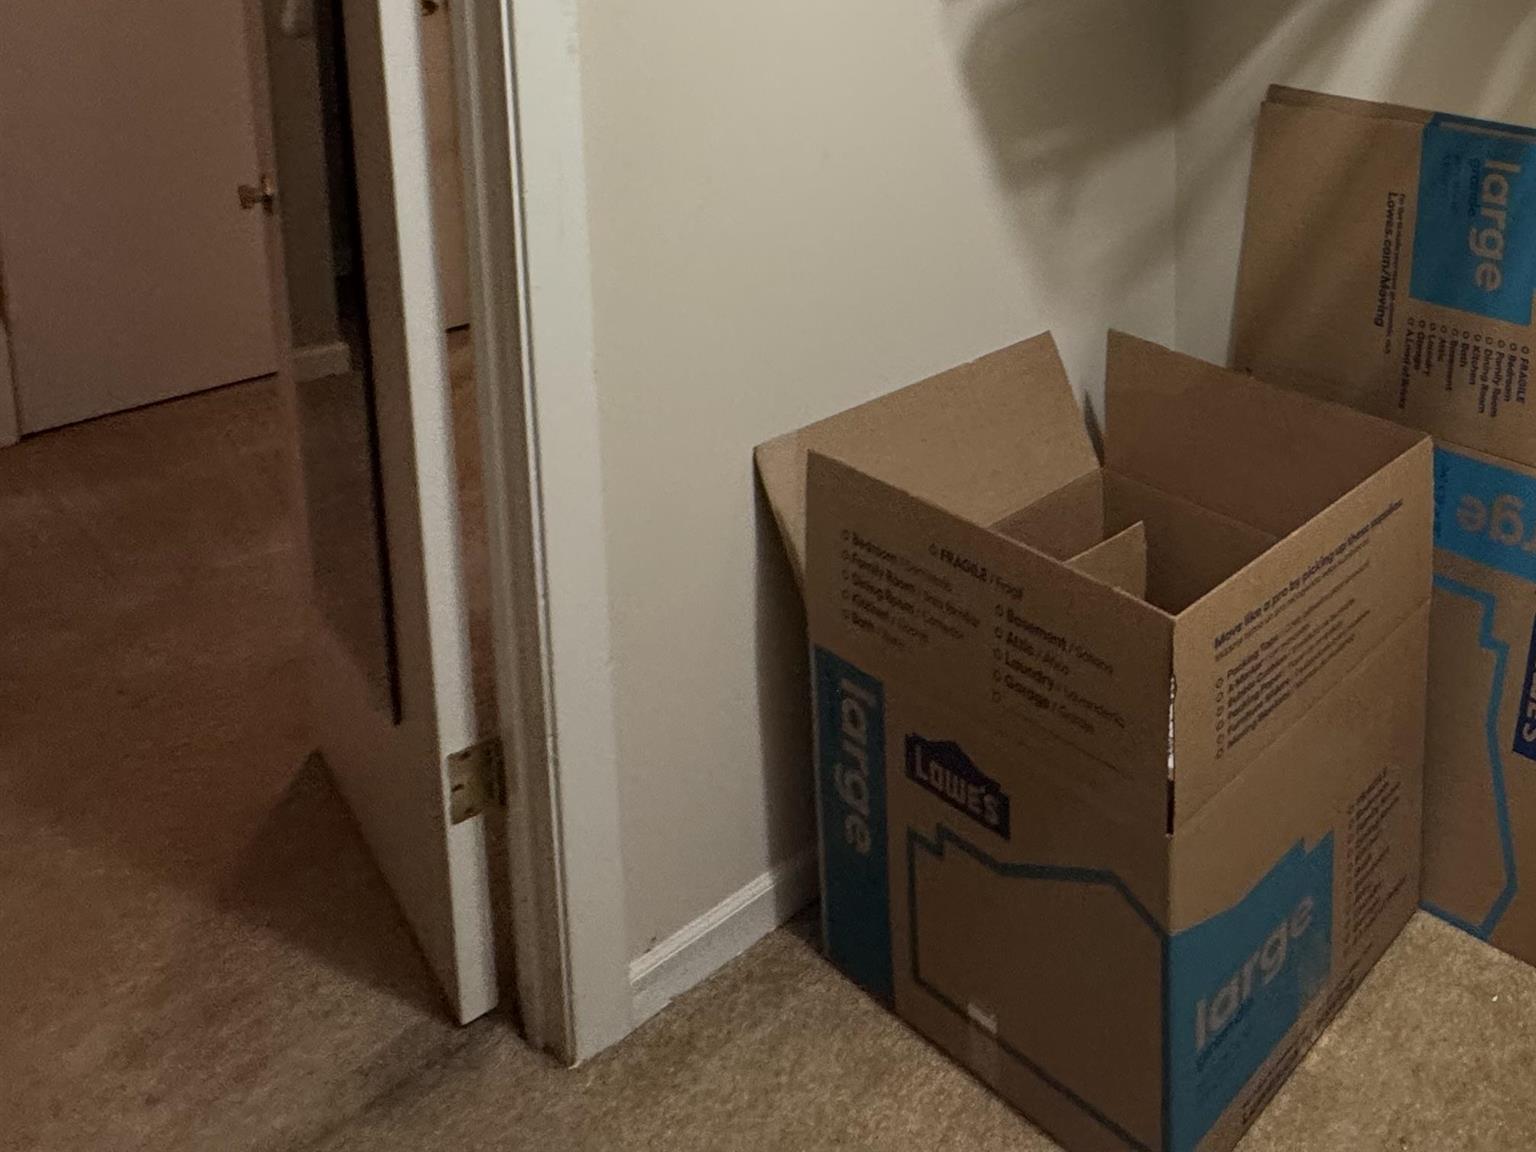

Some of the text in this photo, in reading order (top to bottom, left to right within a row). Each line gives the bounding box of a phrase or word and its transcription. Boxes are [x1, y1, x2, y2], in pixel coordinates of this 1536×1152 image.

[1468, 160, 1521, 292] large
[1515, 357, 1530, 403] FRAGILE
[833, 678, 876, 854] large
[1195, 896, 1313, 1053] large
